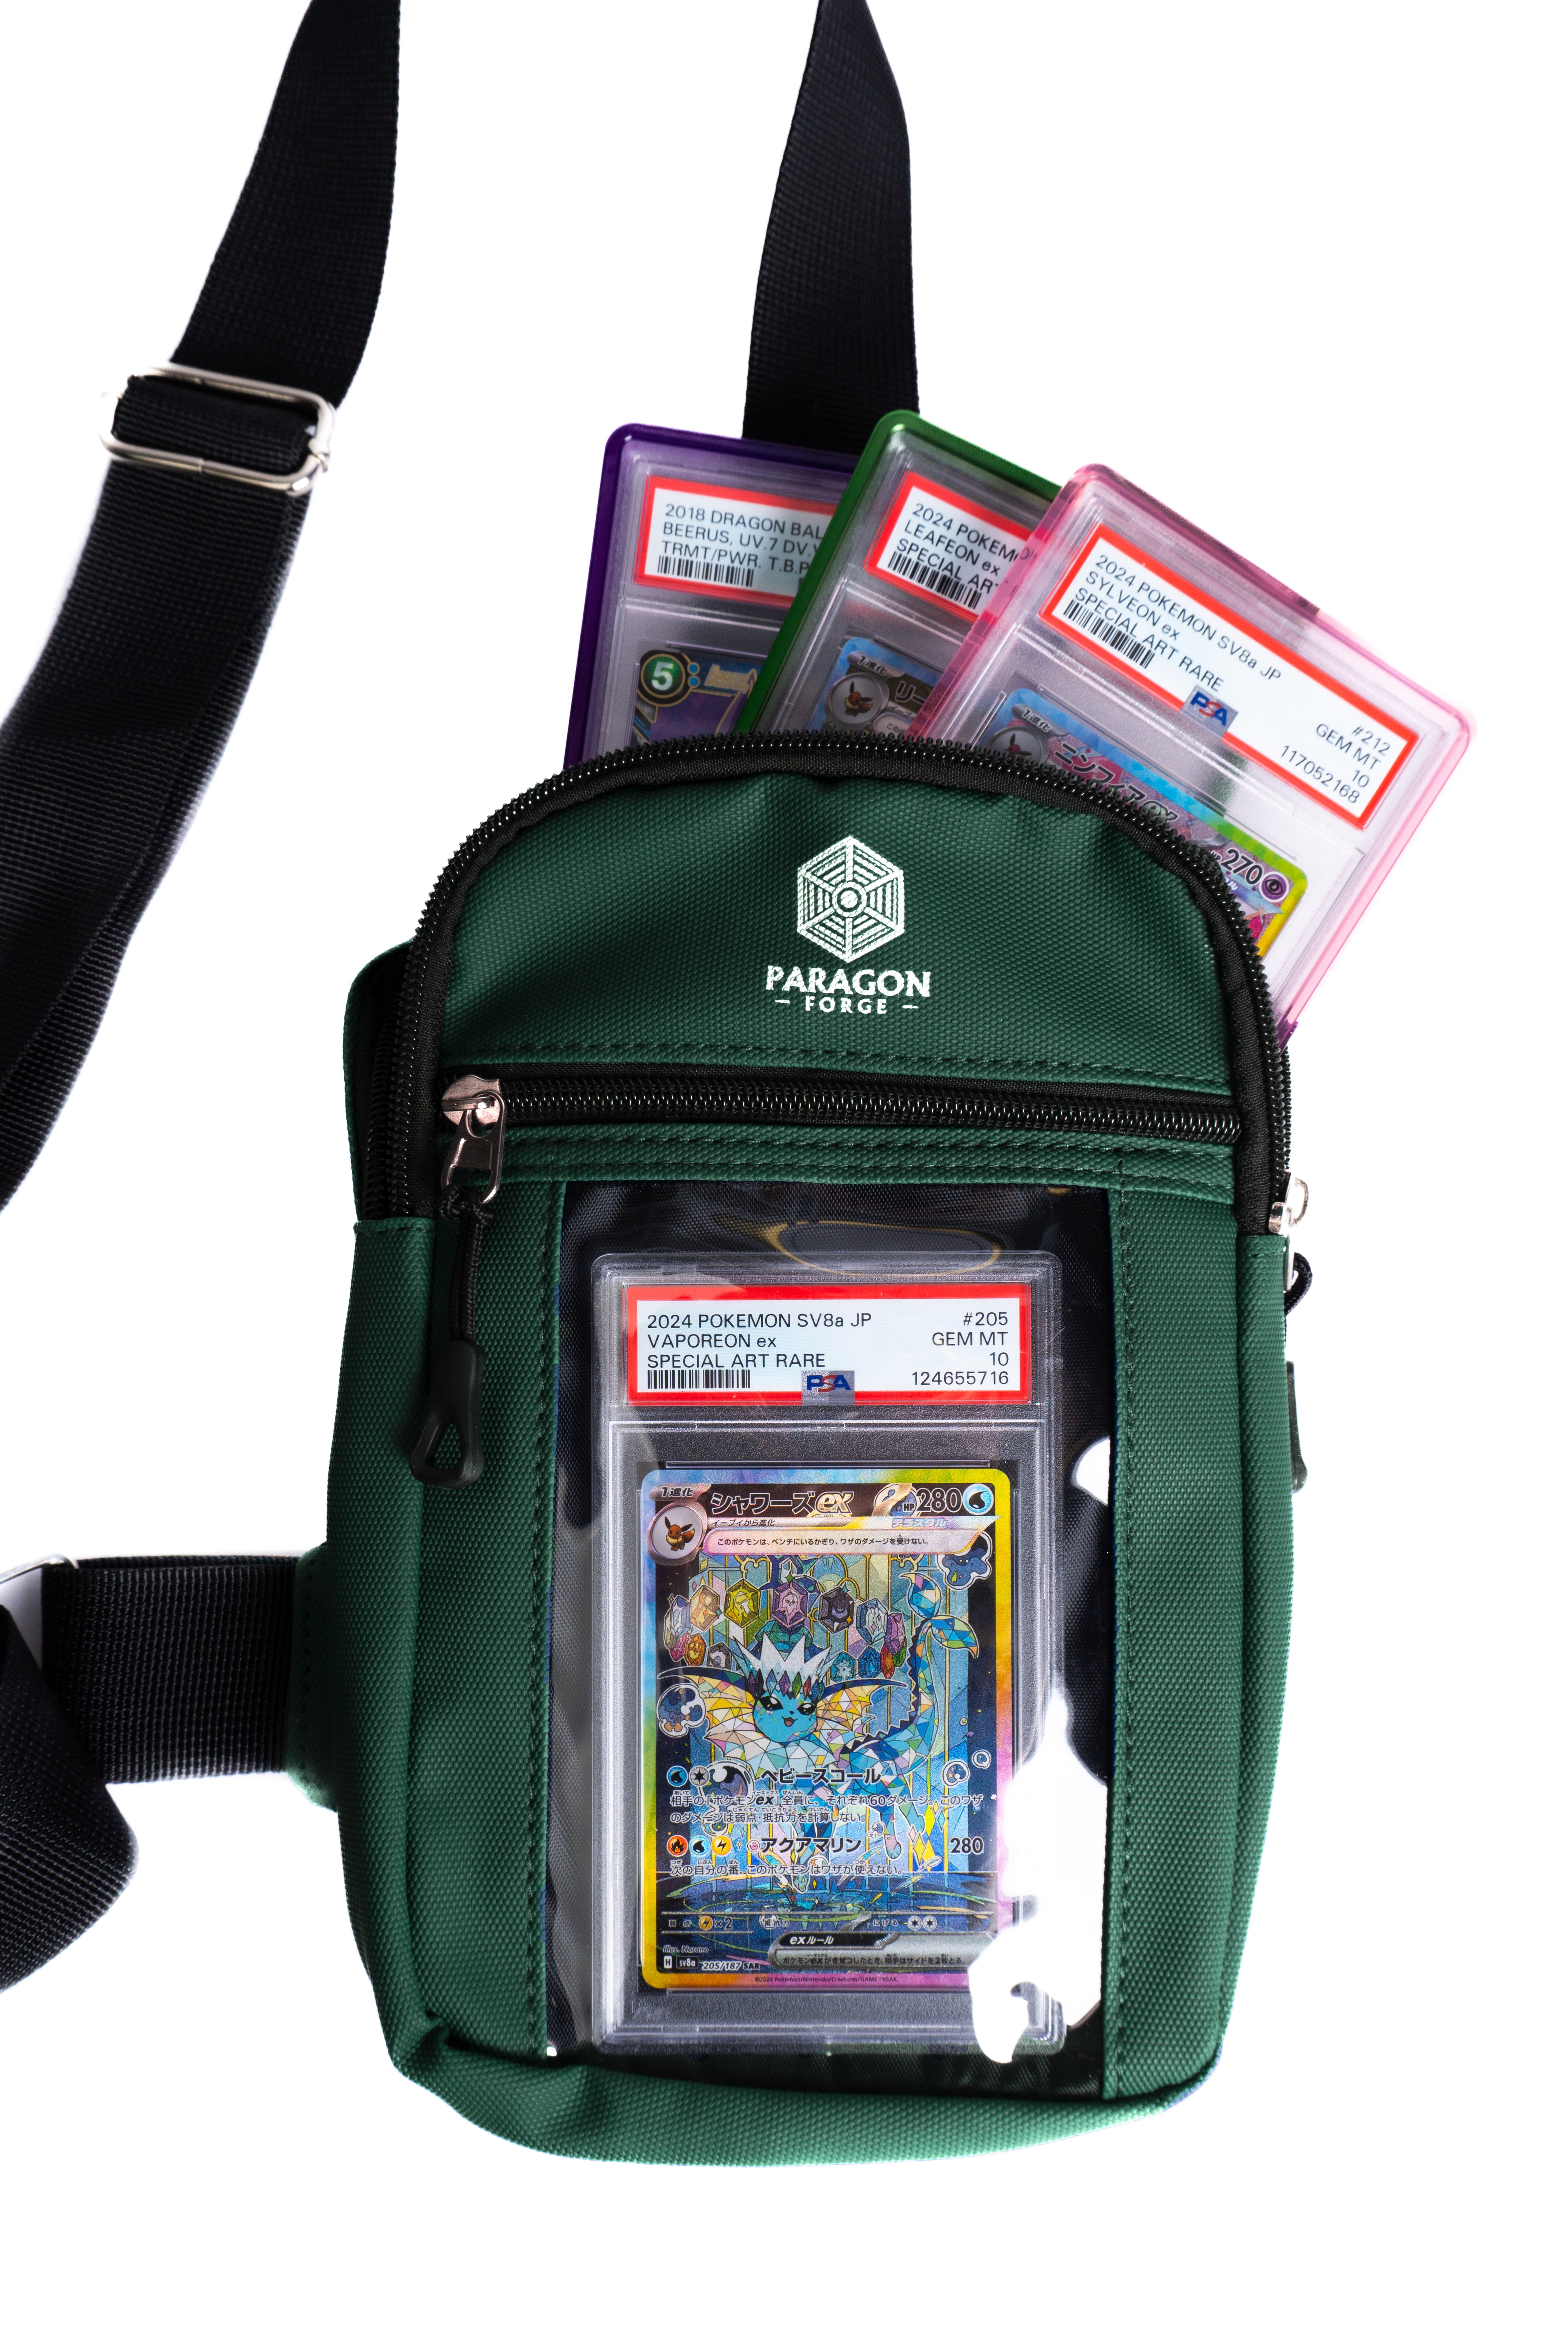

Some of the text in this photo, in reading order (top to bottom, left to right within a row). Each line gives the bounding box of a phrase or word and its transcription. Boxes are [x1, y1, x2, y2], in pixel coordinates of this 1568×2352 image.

[665, 503, 705, 521] 2018
[710, 510, 785, 534] DRAGON
[912, 503, 954, 531] 2024
[663, 522, 733, 546] BEERUS,
[739, 532, 778, 550] UV.7
[661, 540, 762, 568] TRMT/PWR.
[904, 519, 1000, 576] LEAFEON ex
[896, 539, 962, 581] SPECIAL
[1086, 571, 1181, 641] SYLVEON ex
[1095, 555, 1281, 680] 2024 POKEMON SV8a JP
[1075, 588, 1224, 692] SPECIAL ART RARE
[651, 662, 673, 690] 5
[1190, 690, 1228, 727] PSA
[1021, 708, 1053, 733] 1進化
[1316, 723, 1381, 770] GEM MT
[1351, 725, 1391, 756] #212
[1281, 745, 1360, 804] 117052168
[1352, 770, 1370, 788] 10
[1219, 848, 1264, 886] 270
[766, 965, 931, 997] PARAGON
[805, 995, 887, 1014] FORGE
[647, 1312, 872, 1329] 2024 POKEMON SV8a JP
[962, 1311, 1008, 1326] #205
[647, 1333, 777, 1348] VAPOREON ex
[931, 1331, 1009, 1346] GEM MT
[647, 1353, 826, 1368] SPECIAL ART RARE
[990, 1352, 1009, 1366] 10
[806, 1374, 852, 1393] PSA
[911, 1371, 1009, 1385] 124655716
[661, 1486, 695, 1498] 1進化
[891, 1517, 948, 1528] テラスタル
[760, 1768, 882, 1784] ヘビースコール
[760, 1837, 862, 1853] アクアマリン
[950, 1837, 984, 1854] 280
[681, 1945, 709, 1953] Narano
[789, 1936, 834, 1945] exルール
[664, 1957, 672, 1967] H
[702, 1961, 742, 1971] 205/187
[743, 1962, 760, 1970] SAR
